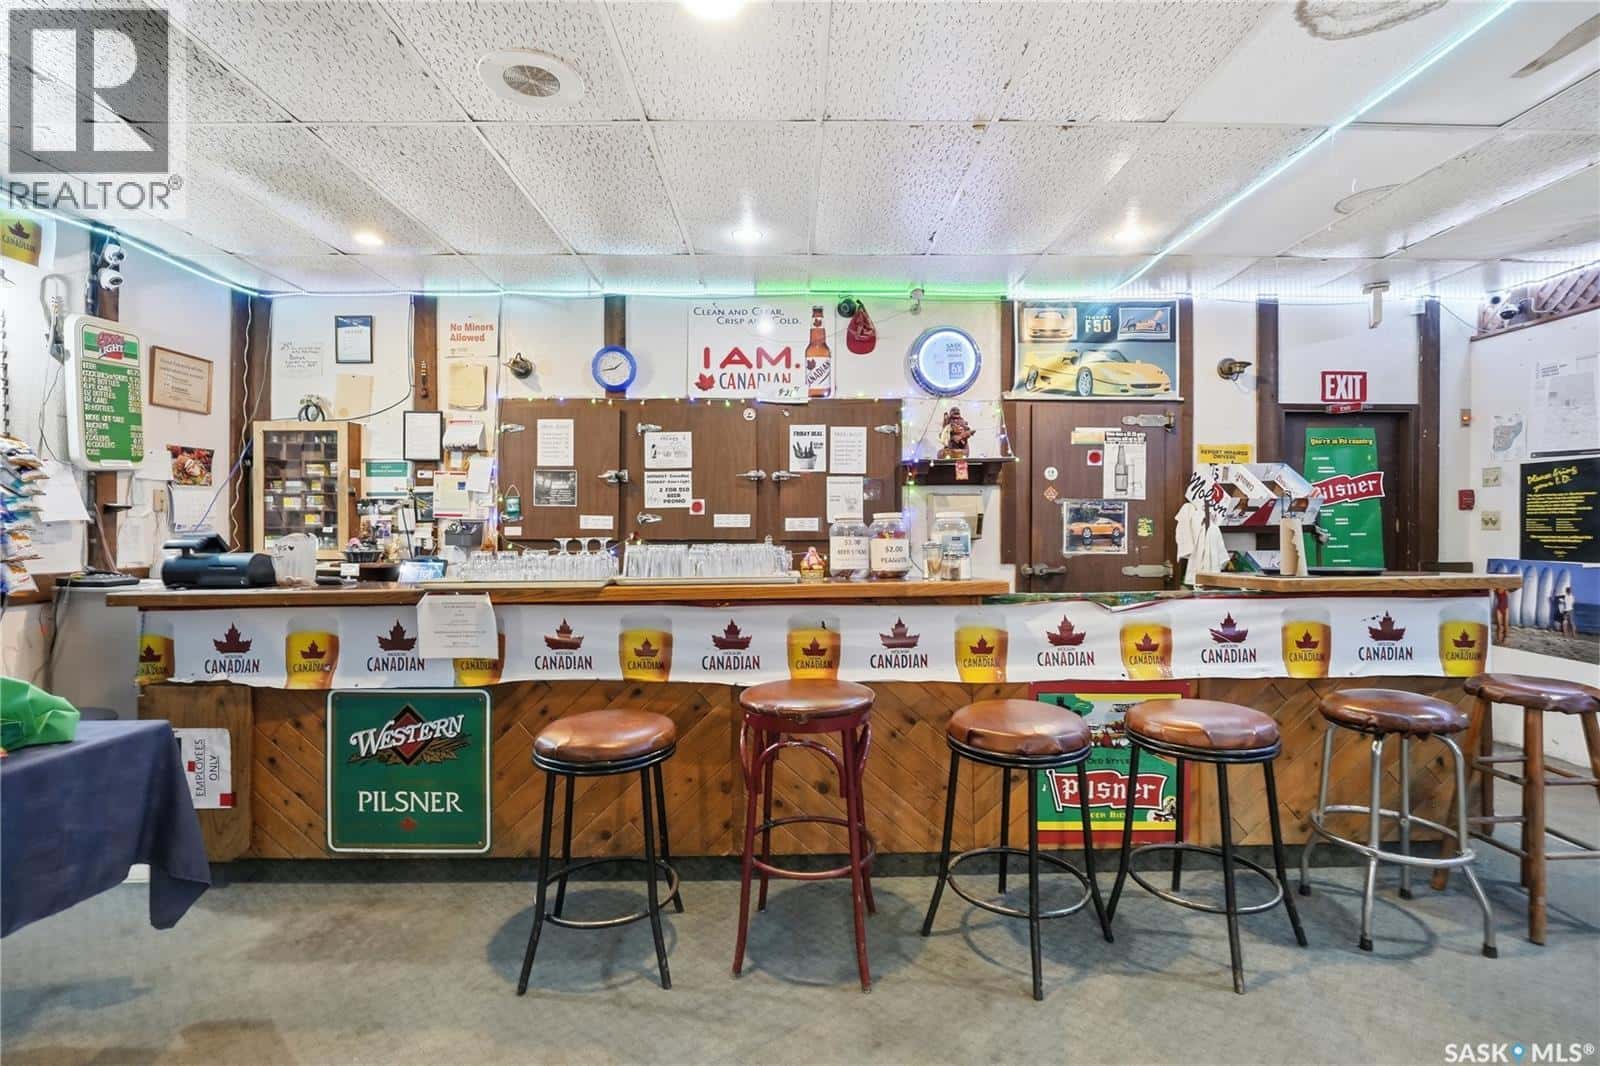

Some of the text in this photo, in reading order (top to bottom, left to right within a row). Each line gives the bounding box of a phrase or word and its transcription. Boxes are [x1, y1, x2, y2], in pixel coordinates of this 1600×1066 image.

[450, 322, 494, 332] No Minors
[1085, 319, 1111, 333] F50
[450, 333, 485, 342] Allowed
[98, 343, 124, 356] LIGHT
[703, 347, 801, 369] I AM.
[719, 373, 791, 390] CANADIAN
[1325, 375, 1363, 400] EXIT
[1037, 651, 1095, 667] CANADIAN
[1200, 646, 1257, 663] CANADIAN
[1358, 644, 1413, 661] CANADIAN
[204, 659, 260, 674] CANADIAN
[366, 657, 425, 672] CANADIAN
[534, 655, 593, 671] CANADIAN
[701, 655, 761, 671] CANADIAN
[795, 659, 834, 669] CANADIAN
[870, 653, 928, 669] CANADIAN
[349, 715, 464, 756] WESTERN
[195, 738, 206, 797] EMPLOYEES
[208, 755, 219, 782] ONLY
[1061, 778, 1156, 800] Plsner
[358, 791, 462, 813] PILSNER
